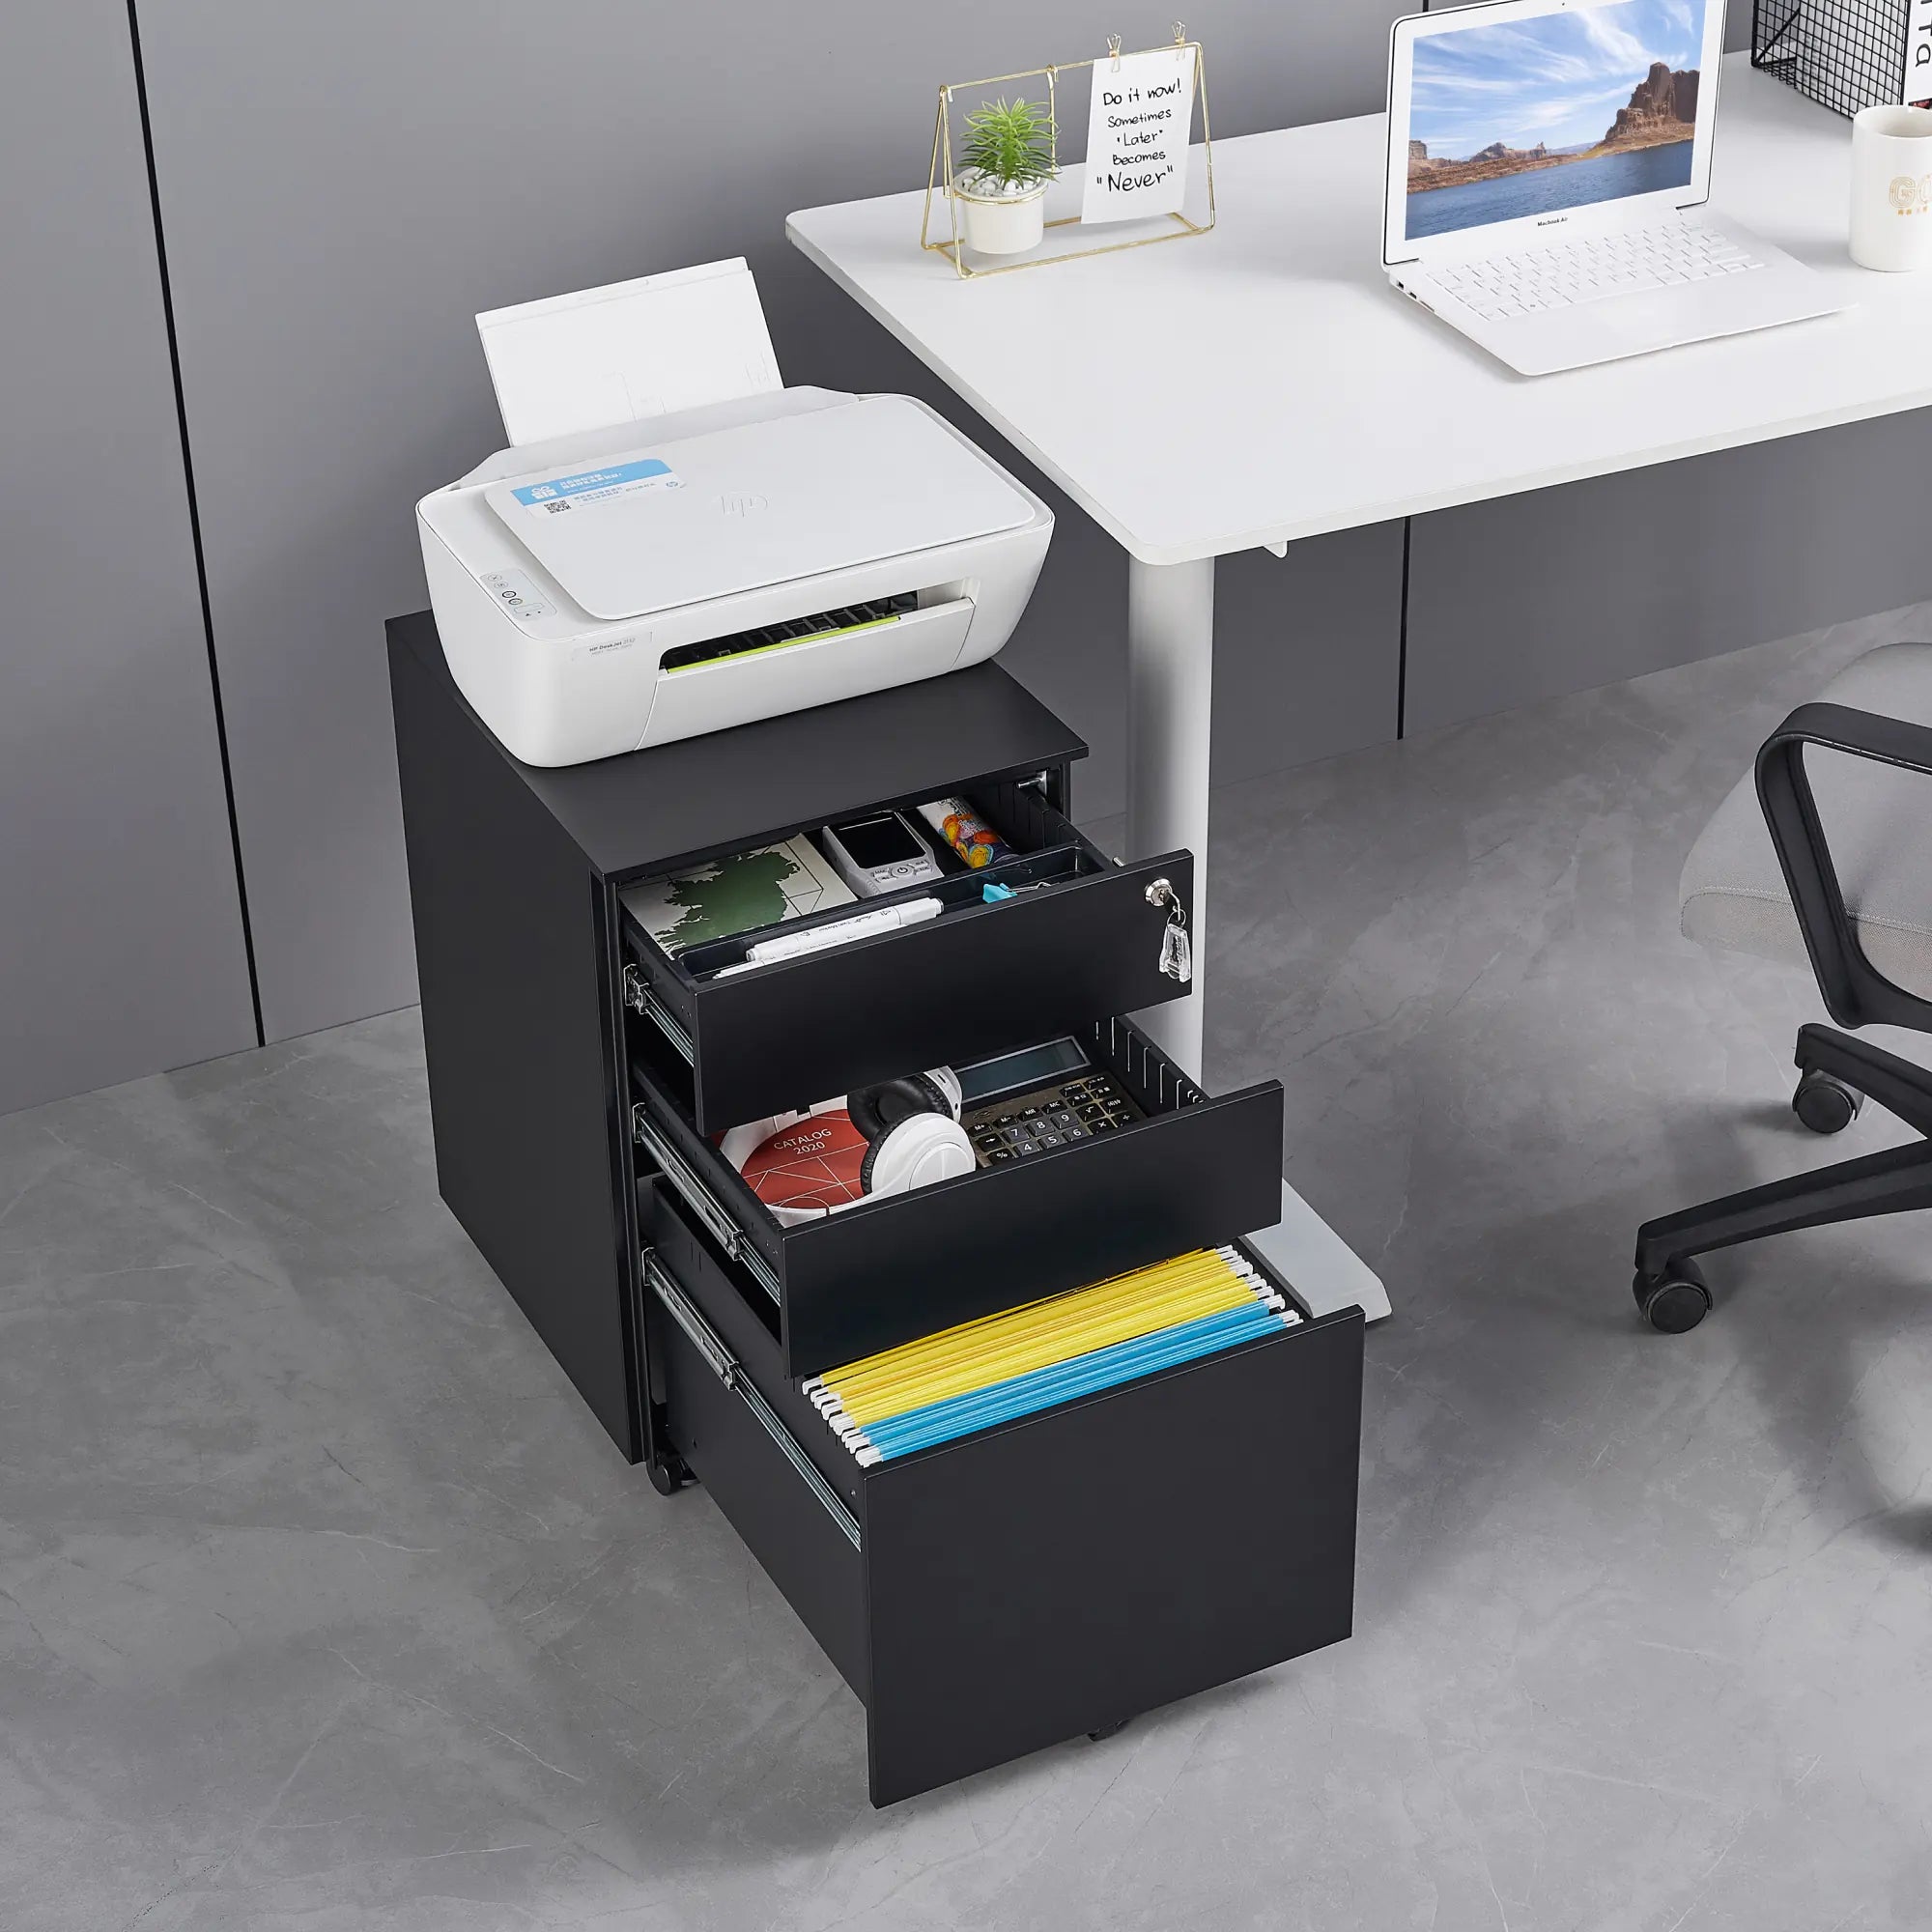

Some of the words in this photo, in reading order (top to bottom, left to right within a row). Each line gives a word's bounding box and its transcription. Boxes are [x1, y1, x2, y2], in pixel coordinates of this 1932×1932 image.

[1103, 92, 1122, 105] Do
[1128, 88, 1140, 102] it
[1148, 77, 1181, 99] now!
[1107, 108, 1172, 128] Sometimes
[1113, 150, 1166, 165] Becomes
[1096, 165, 1173, 192] "Never"
[1061, 1114, 1069, 1122] 9
[1037, 1121, 1046, 1129] 8
[1010, 1128, 1019, 1137] 7
[1072, 1128, 1082, 1137] 6
[774, 1128, 832, 1150] CATALOG
[1048, 1135, 1057, 1145] 5
[793, 1141, 826, 1155] 2020
[1024, 1143, 1033, 1152] 4
